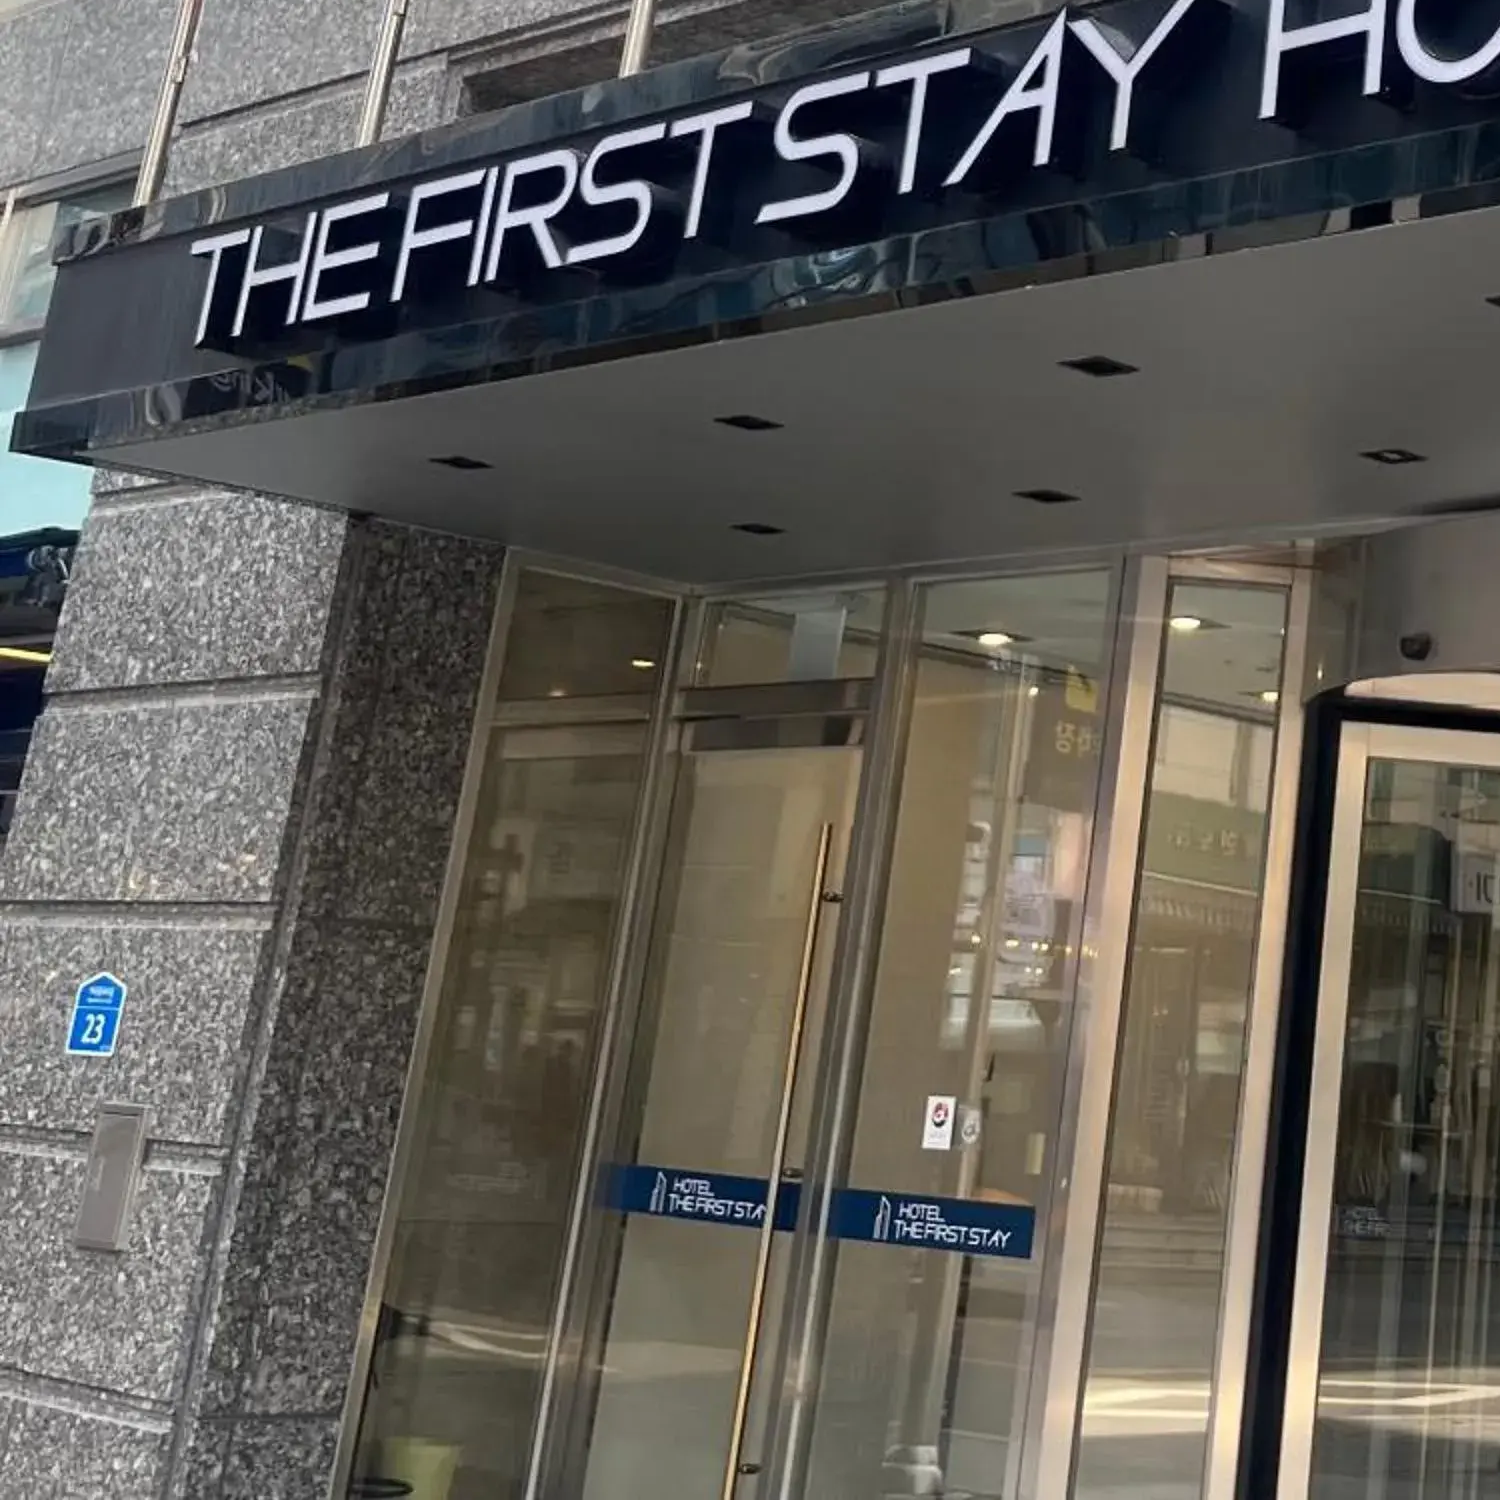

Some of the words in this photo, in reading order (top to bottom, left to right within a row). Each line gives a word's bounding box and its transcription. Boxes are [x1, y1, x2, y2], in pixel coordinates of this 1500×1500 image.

[191, 193, 389, 347] THE
[391, 101, 753, 302] FIRST
[81, 1013, 106, 1044] 23
[673, 1178, 715, 1197] HOTEL
[668, 1193, 692, 1212] THE
[733, 1201, 767, 1220] STA
[899, 1201, 945, 1223] HOTEL
[894, 1219, 923, 1240] THE
[924, 1222, 967, 1244] FIRST
[968, 1227, 1012, 1249] STAY
